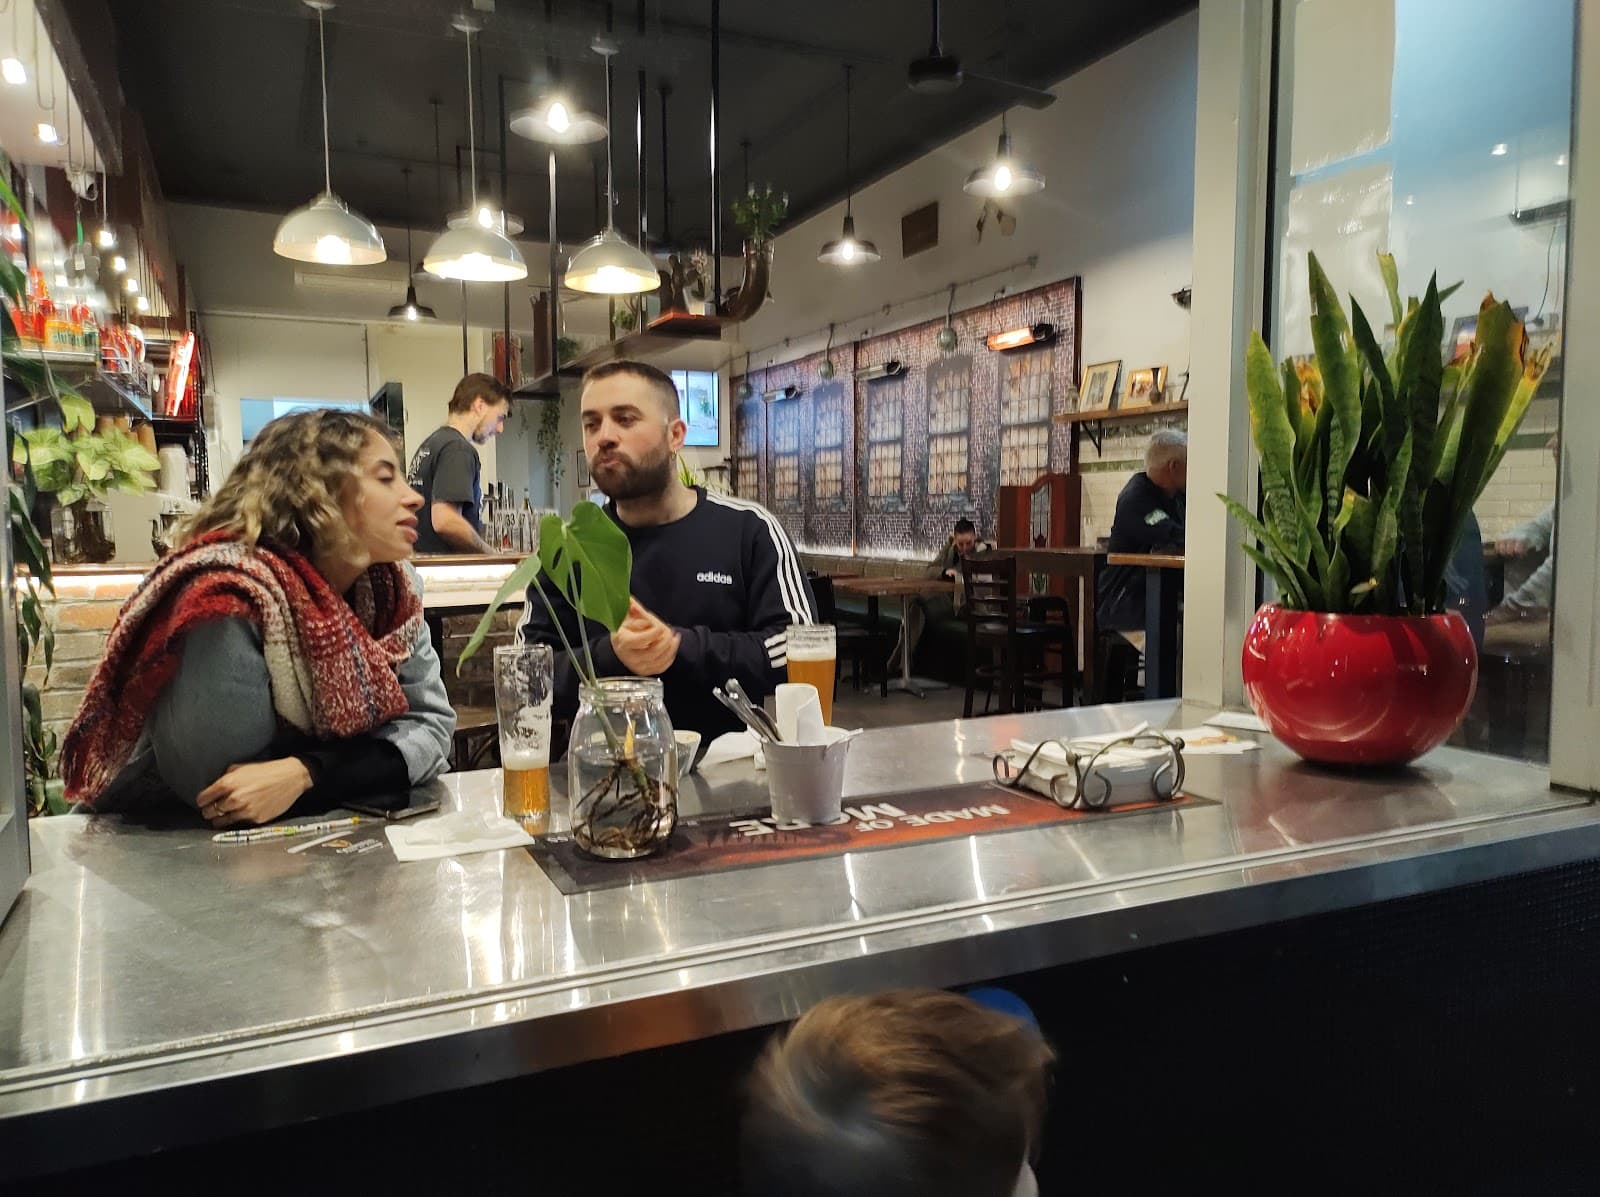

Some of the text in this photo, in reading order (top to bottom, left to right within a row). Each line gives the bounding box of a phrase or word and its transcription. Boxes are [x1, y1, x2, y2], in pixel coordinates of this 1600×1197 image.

[696, 571, 733, 585] adidas
[855, 803, 1010, 831] MADE OF
